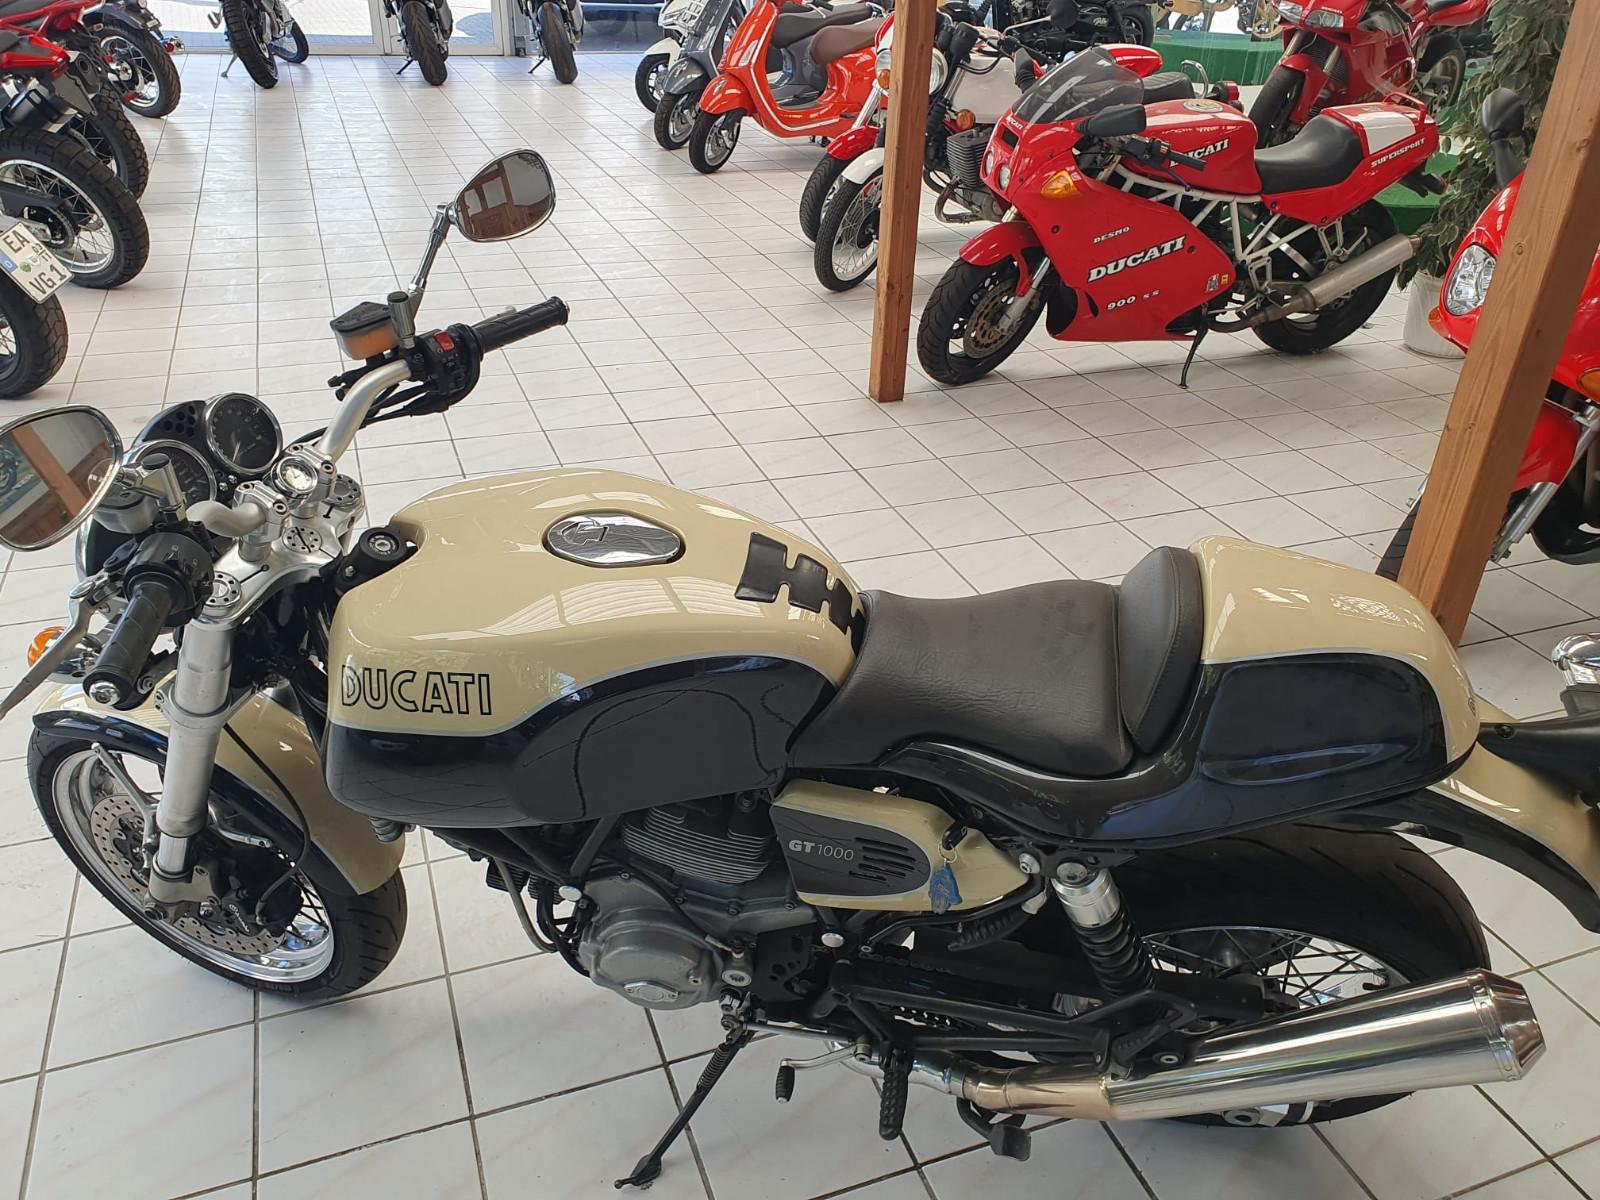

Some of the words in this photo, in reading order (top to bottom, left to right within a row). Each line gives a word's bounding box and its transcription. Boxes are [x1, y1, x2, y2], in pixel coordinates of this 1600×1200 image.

[3, 230, 30, 253] EA
[1093, 226, 1131, 244] DESMO
[1088, 236, 1186, 282] DUCATI
[28, 272, 57, 294] VG
[49, 264, 68, 281] 1
[1106, 296, 1137, 311] 900
[341, 664, 492, 716] DUCATI
[788, 839, 816, 854] GT
[817, 844, 855, 861] 1000
